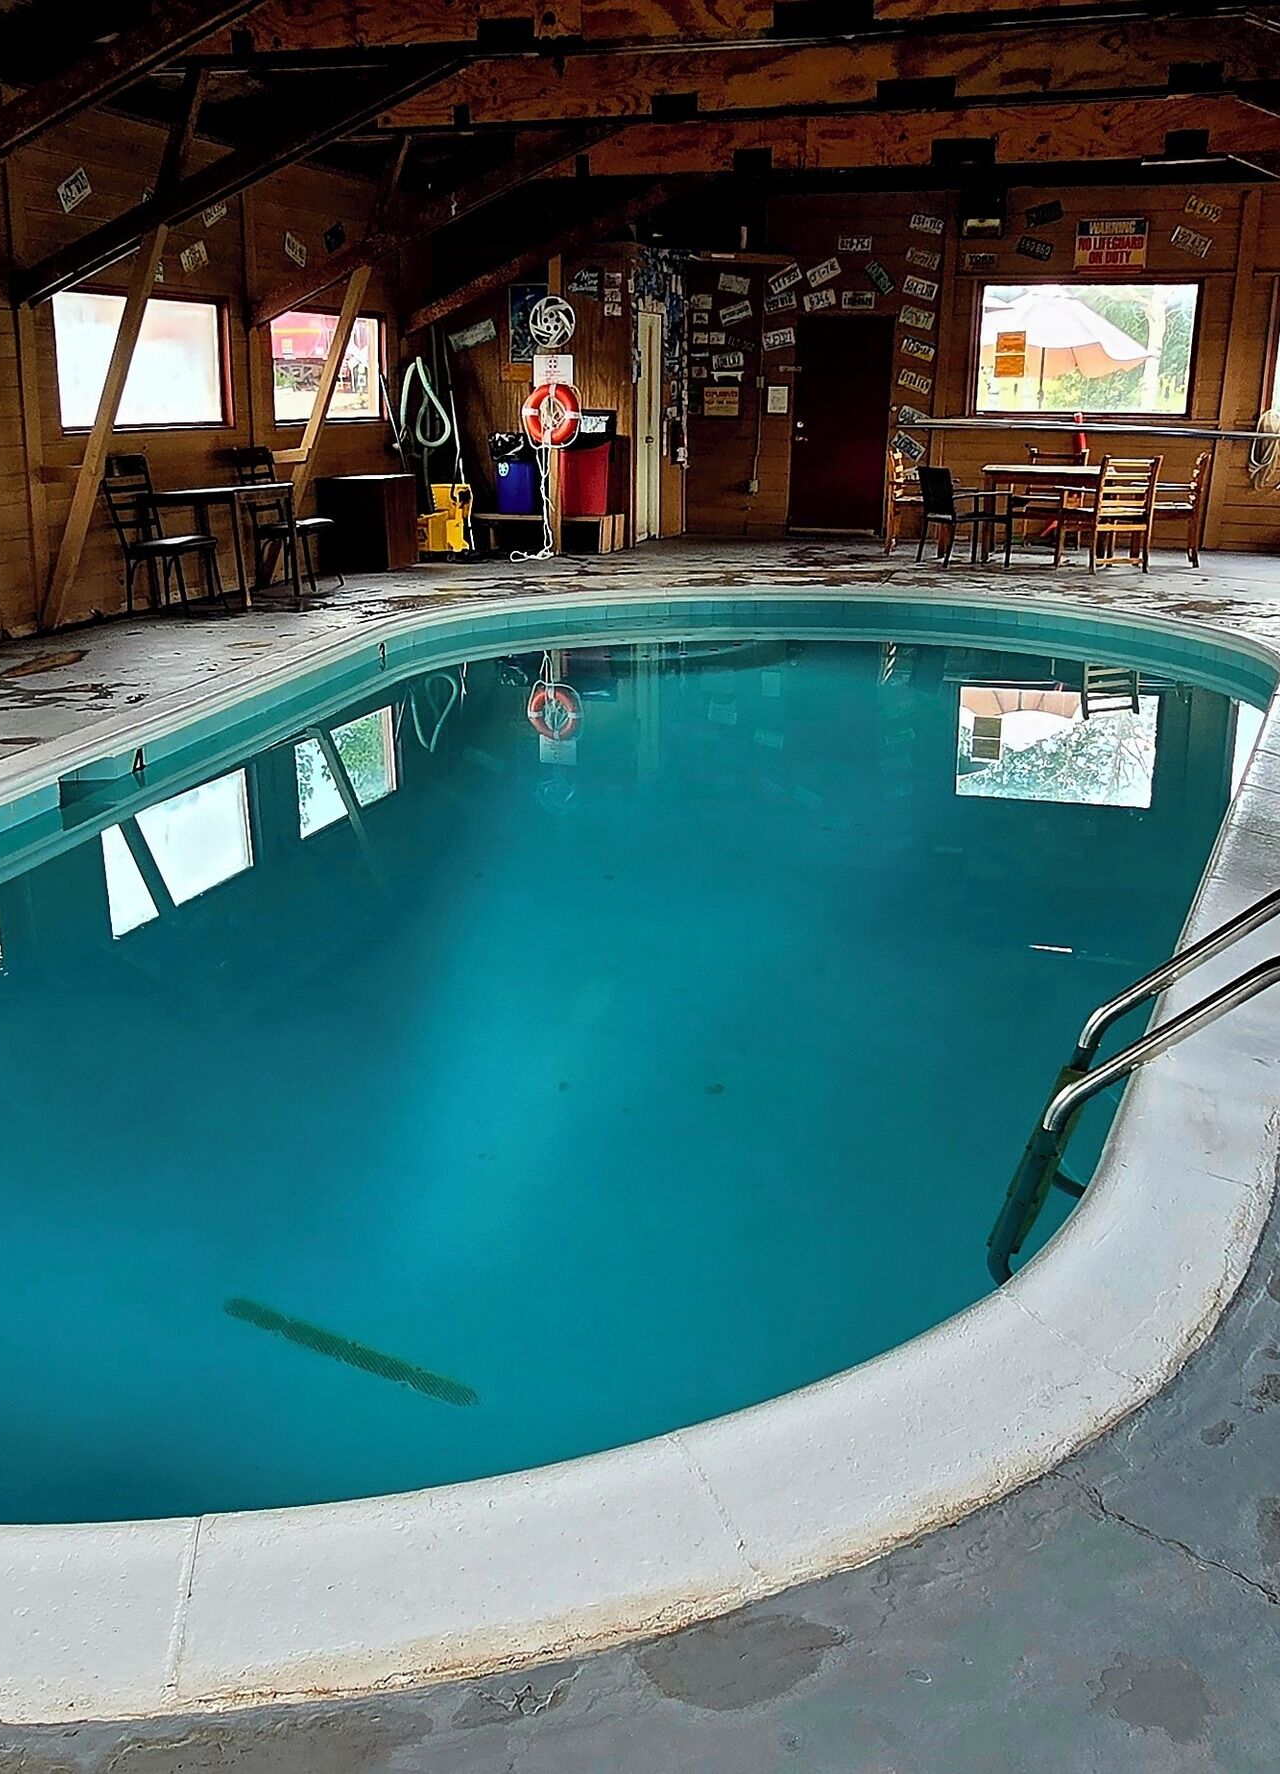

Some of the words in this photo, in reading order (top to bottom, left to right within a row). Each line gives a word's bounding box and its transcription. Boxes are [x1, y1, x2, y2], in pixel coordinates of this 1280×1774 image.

[1089, 221, 1137, 234] WARNING
[1078, 237, 1092, 251] NO
[1093, 236, 1145, 250] LIFEGUARD
[1088, 251, 1103, 264] ON
[1105, 250, 1132, 264] DUTY
[131, 747, 147, 773] 4
